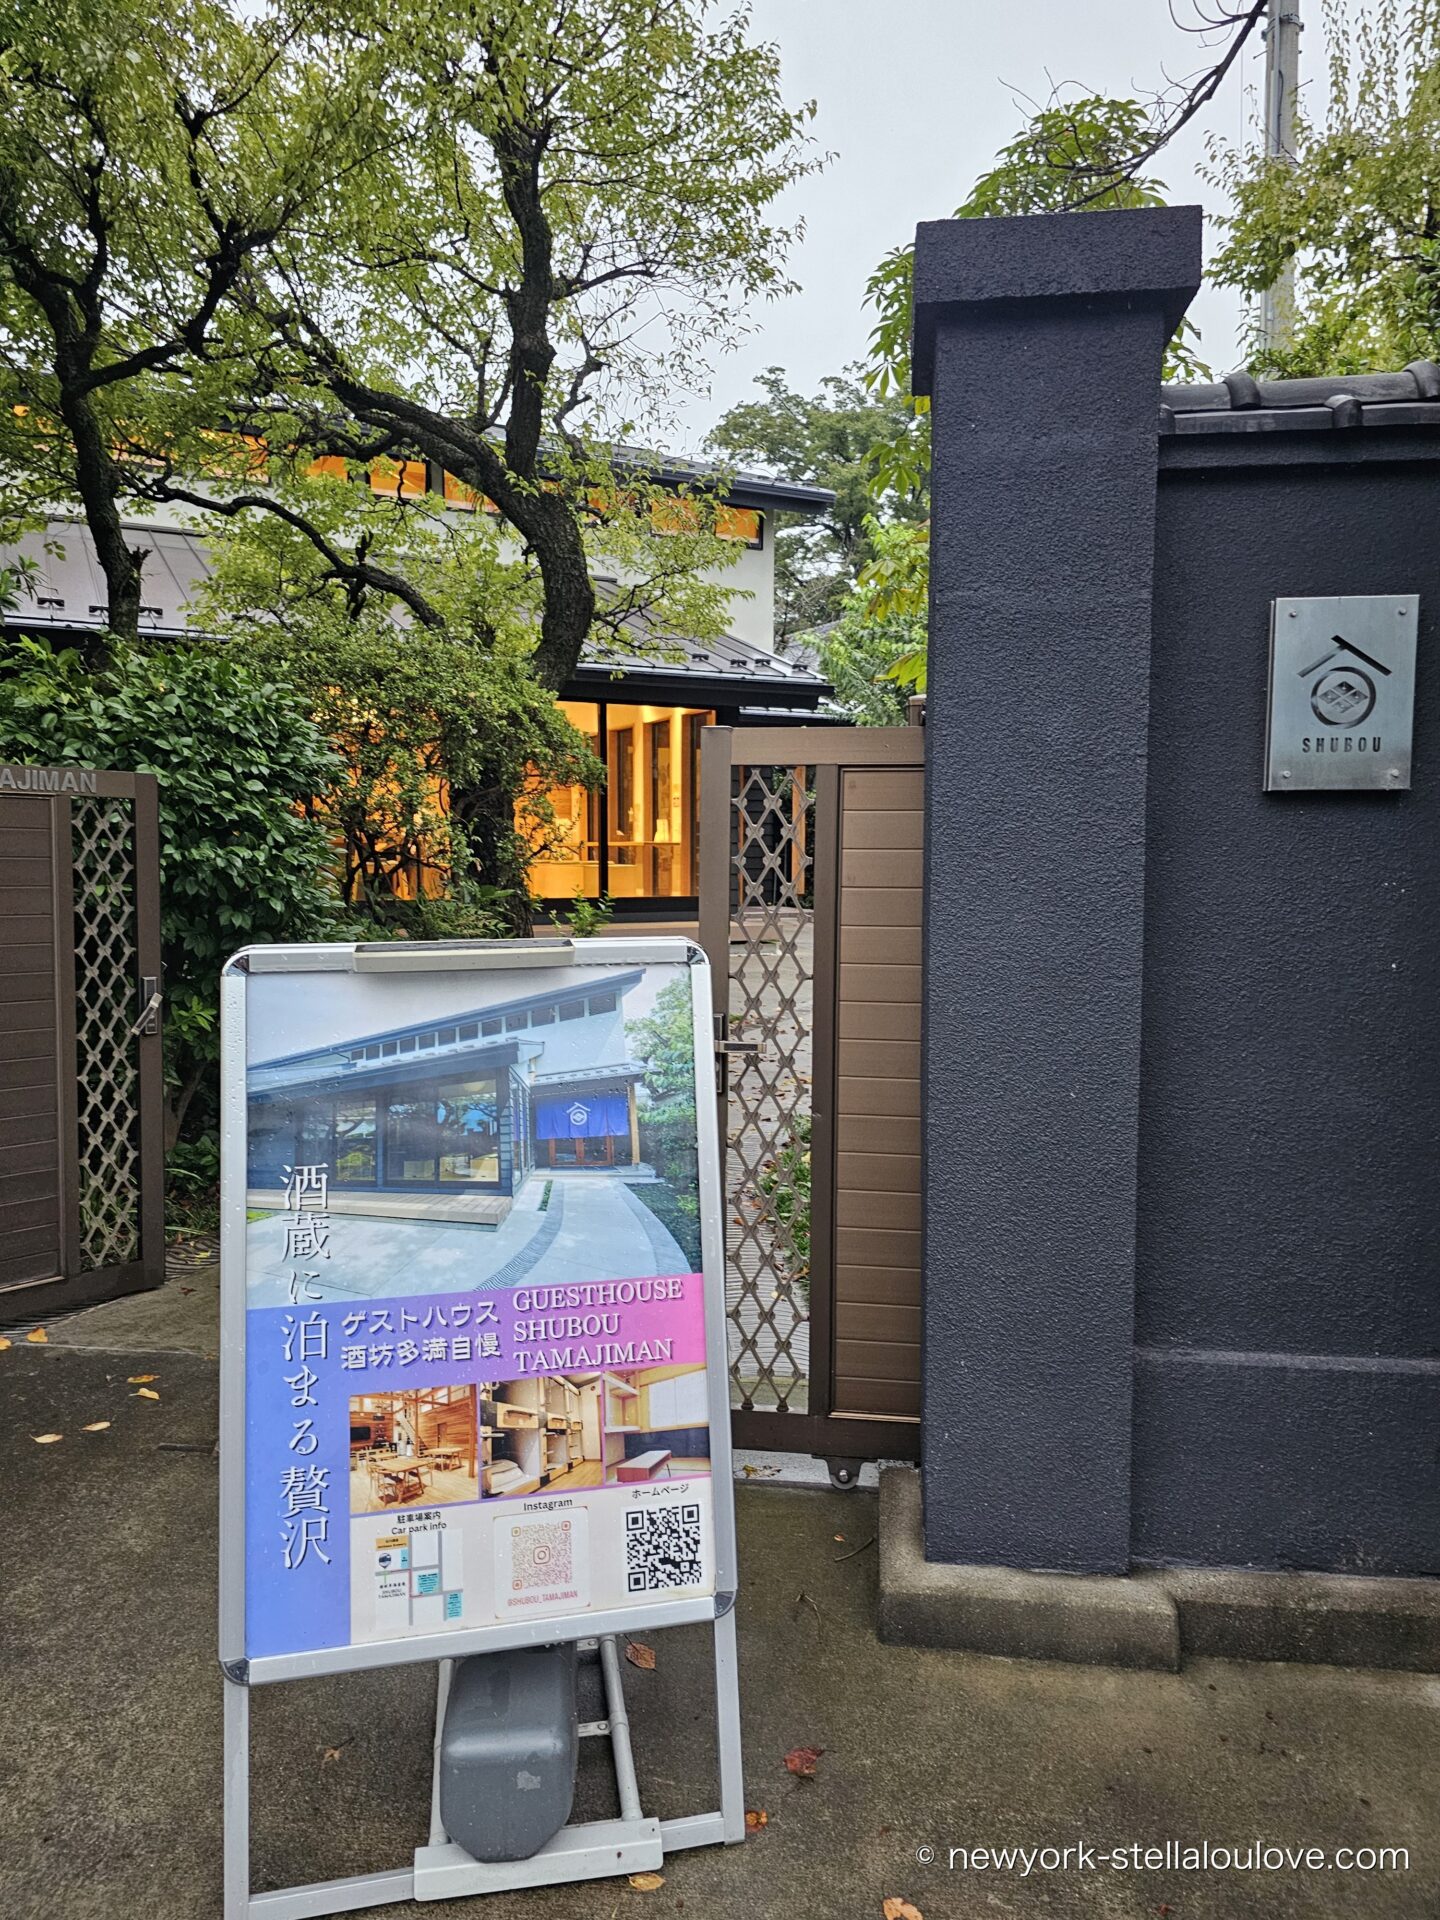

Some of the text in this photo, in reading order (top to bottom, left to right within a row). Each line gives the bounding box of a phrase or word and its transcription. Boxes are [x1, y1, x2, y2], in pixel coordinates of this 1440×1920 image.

[1302, 737, 1381, 753] SHUBOU
[512, 1278, 683, 1312] GUESTHOUSE
[341, 1301, 500, 1337] ゲストハウス
[513, 1313, 620, 1342] SHUBOU
[279, 1162, 332, 1569] 酒蔵に泊まる贅沢
[340, 1332, 501, 1370] 酒坊多満自慢
[513, 1338, 673, 1372] TAMAJIMAN
[523, 1499, 573, 1511] Instagram
[632, 1483, 690, 1499] ホームページ
[391, 1521, 447, 1535] Car park info
